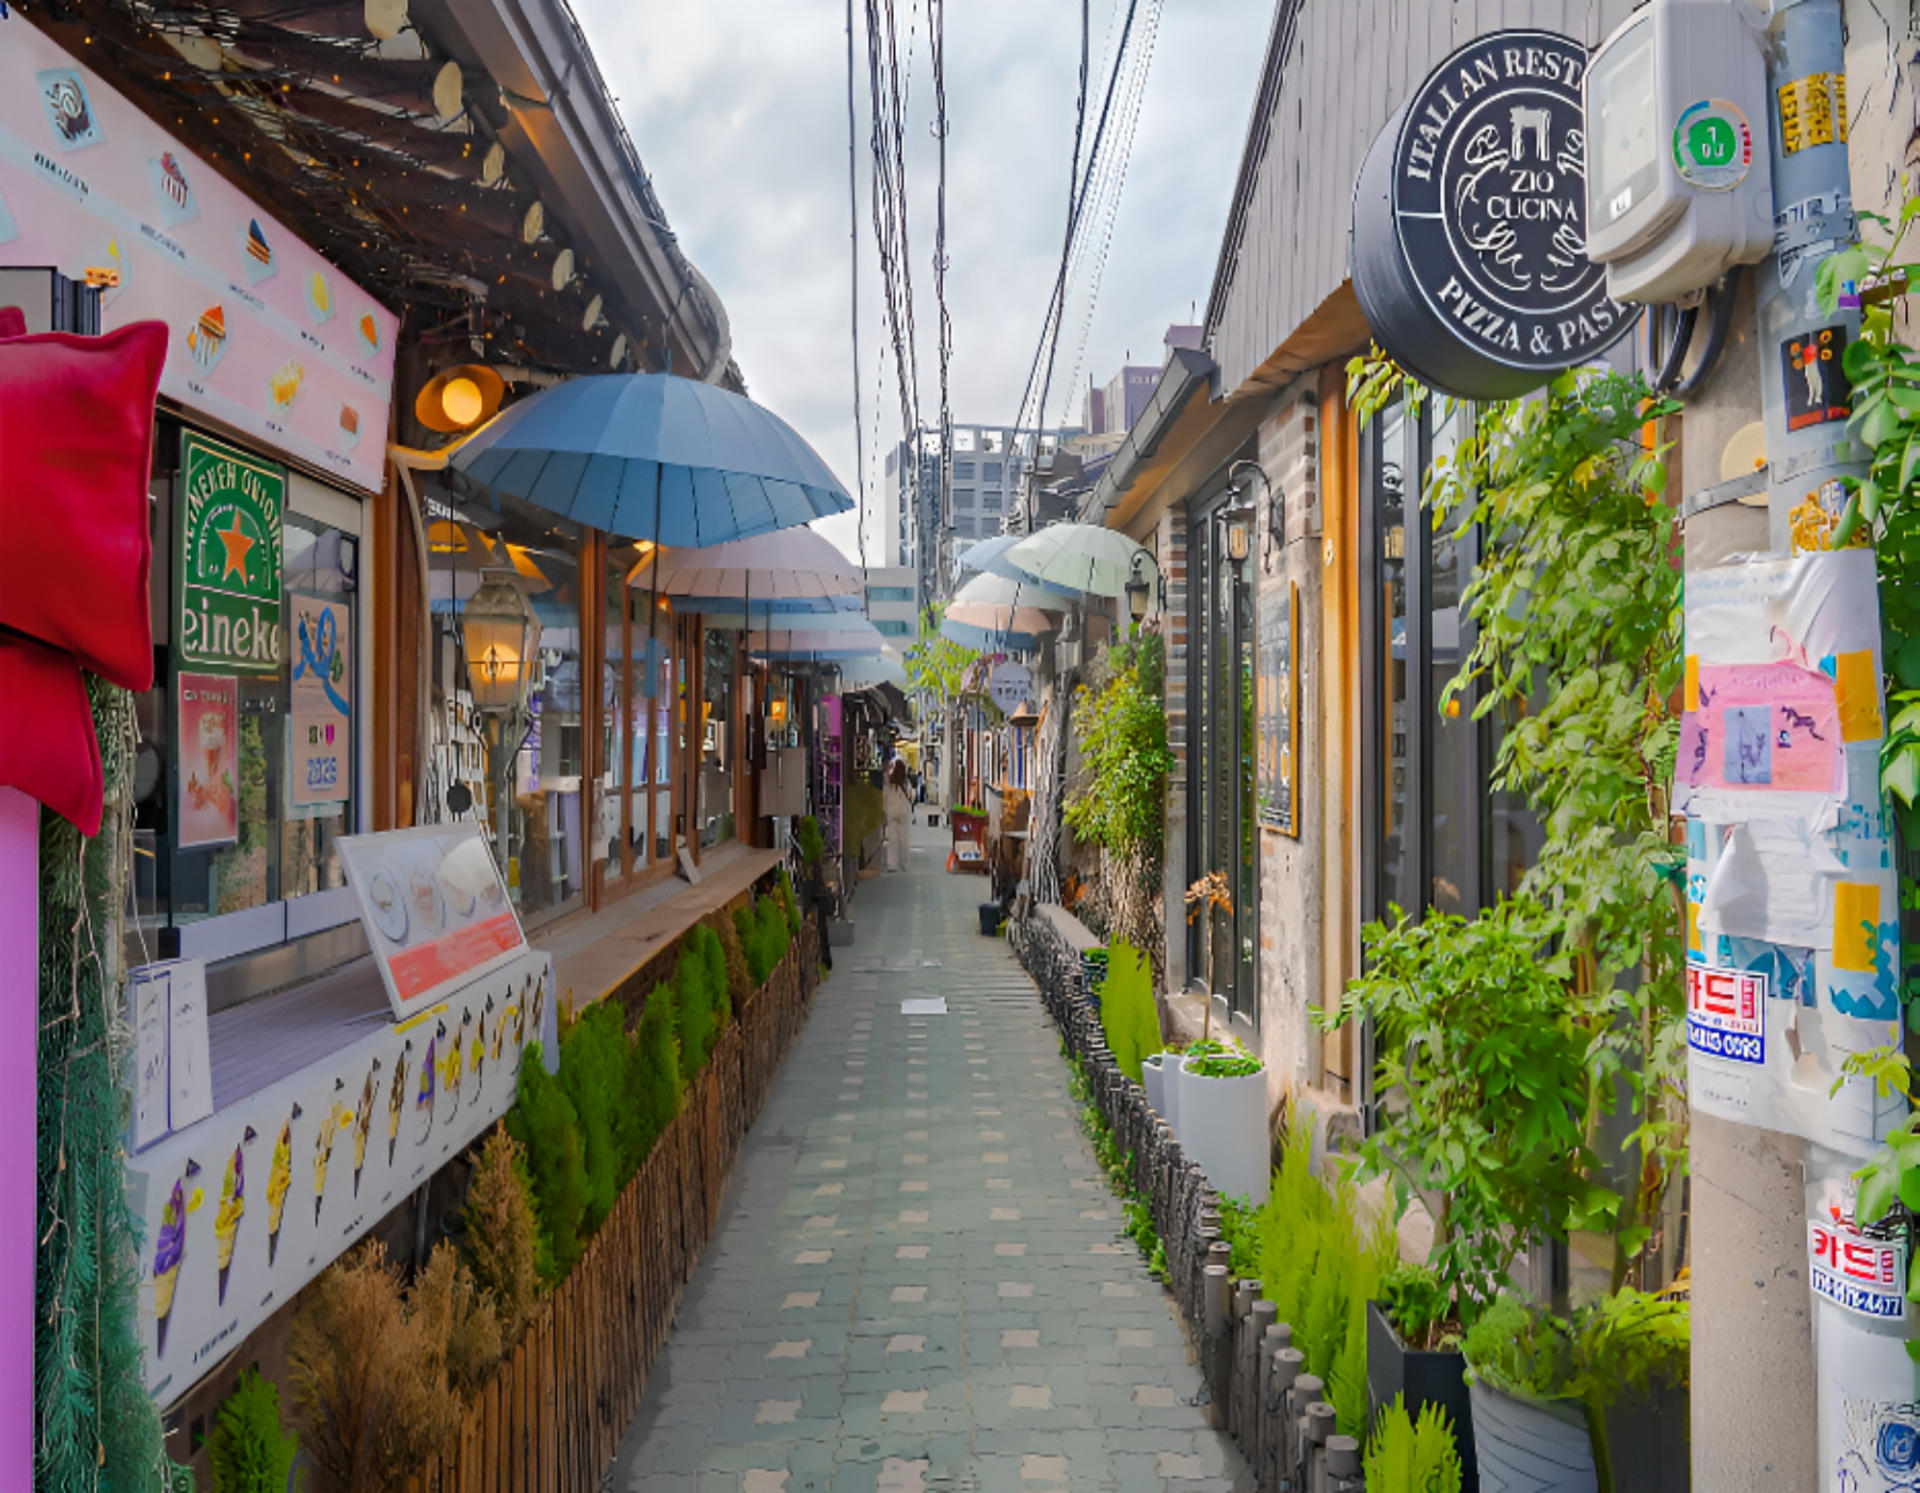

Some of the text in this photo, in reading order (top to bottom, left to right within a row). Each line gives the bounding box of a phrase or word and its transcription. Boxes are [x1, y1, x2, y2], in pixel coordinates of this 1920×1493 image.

[1407, 54, 1498, 183] ITALIAN
[1509, 169, 1554, 193] ZIO
[1487, 196, 1578, 222] CUCINA
[1437, 275, 1637, 355] PIZZA & PAST
[1812, 1228, 1877, 1281] 카드
